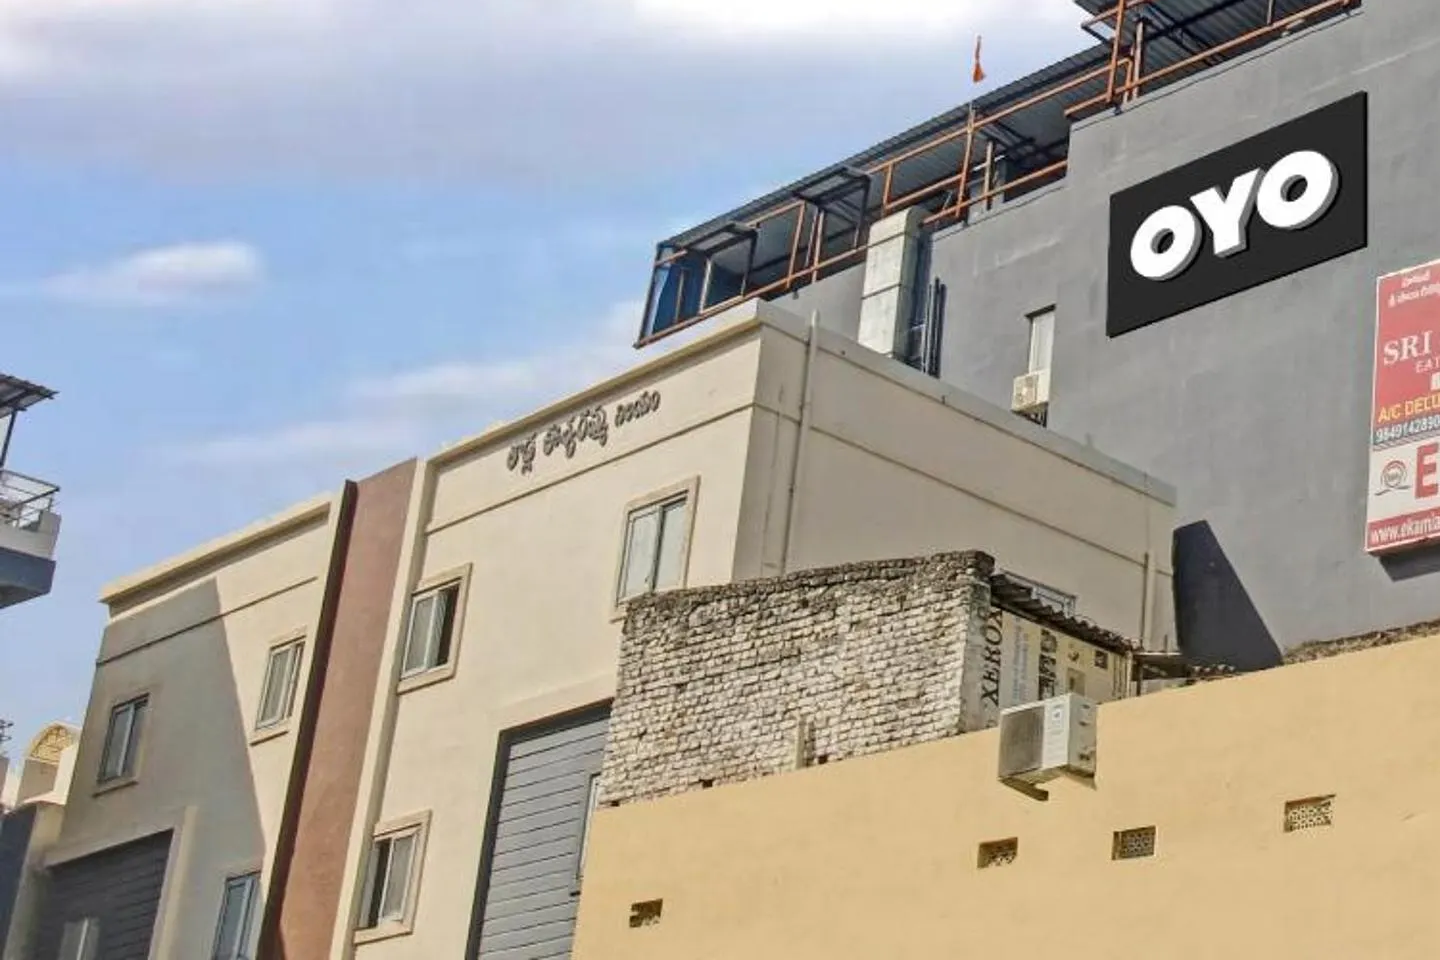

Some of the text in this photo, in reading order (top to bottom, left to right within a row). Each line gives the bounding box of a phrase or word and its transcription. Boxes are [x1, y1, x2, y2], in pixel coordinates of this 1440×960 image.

[1130, 150, 1340, 281] OYO
[1383, 330, 1433, 366] SRI
[1378, 404, 1402, 423] A/C
[979, 606, 1003, 707] XEROX
